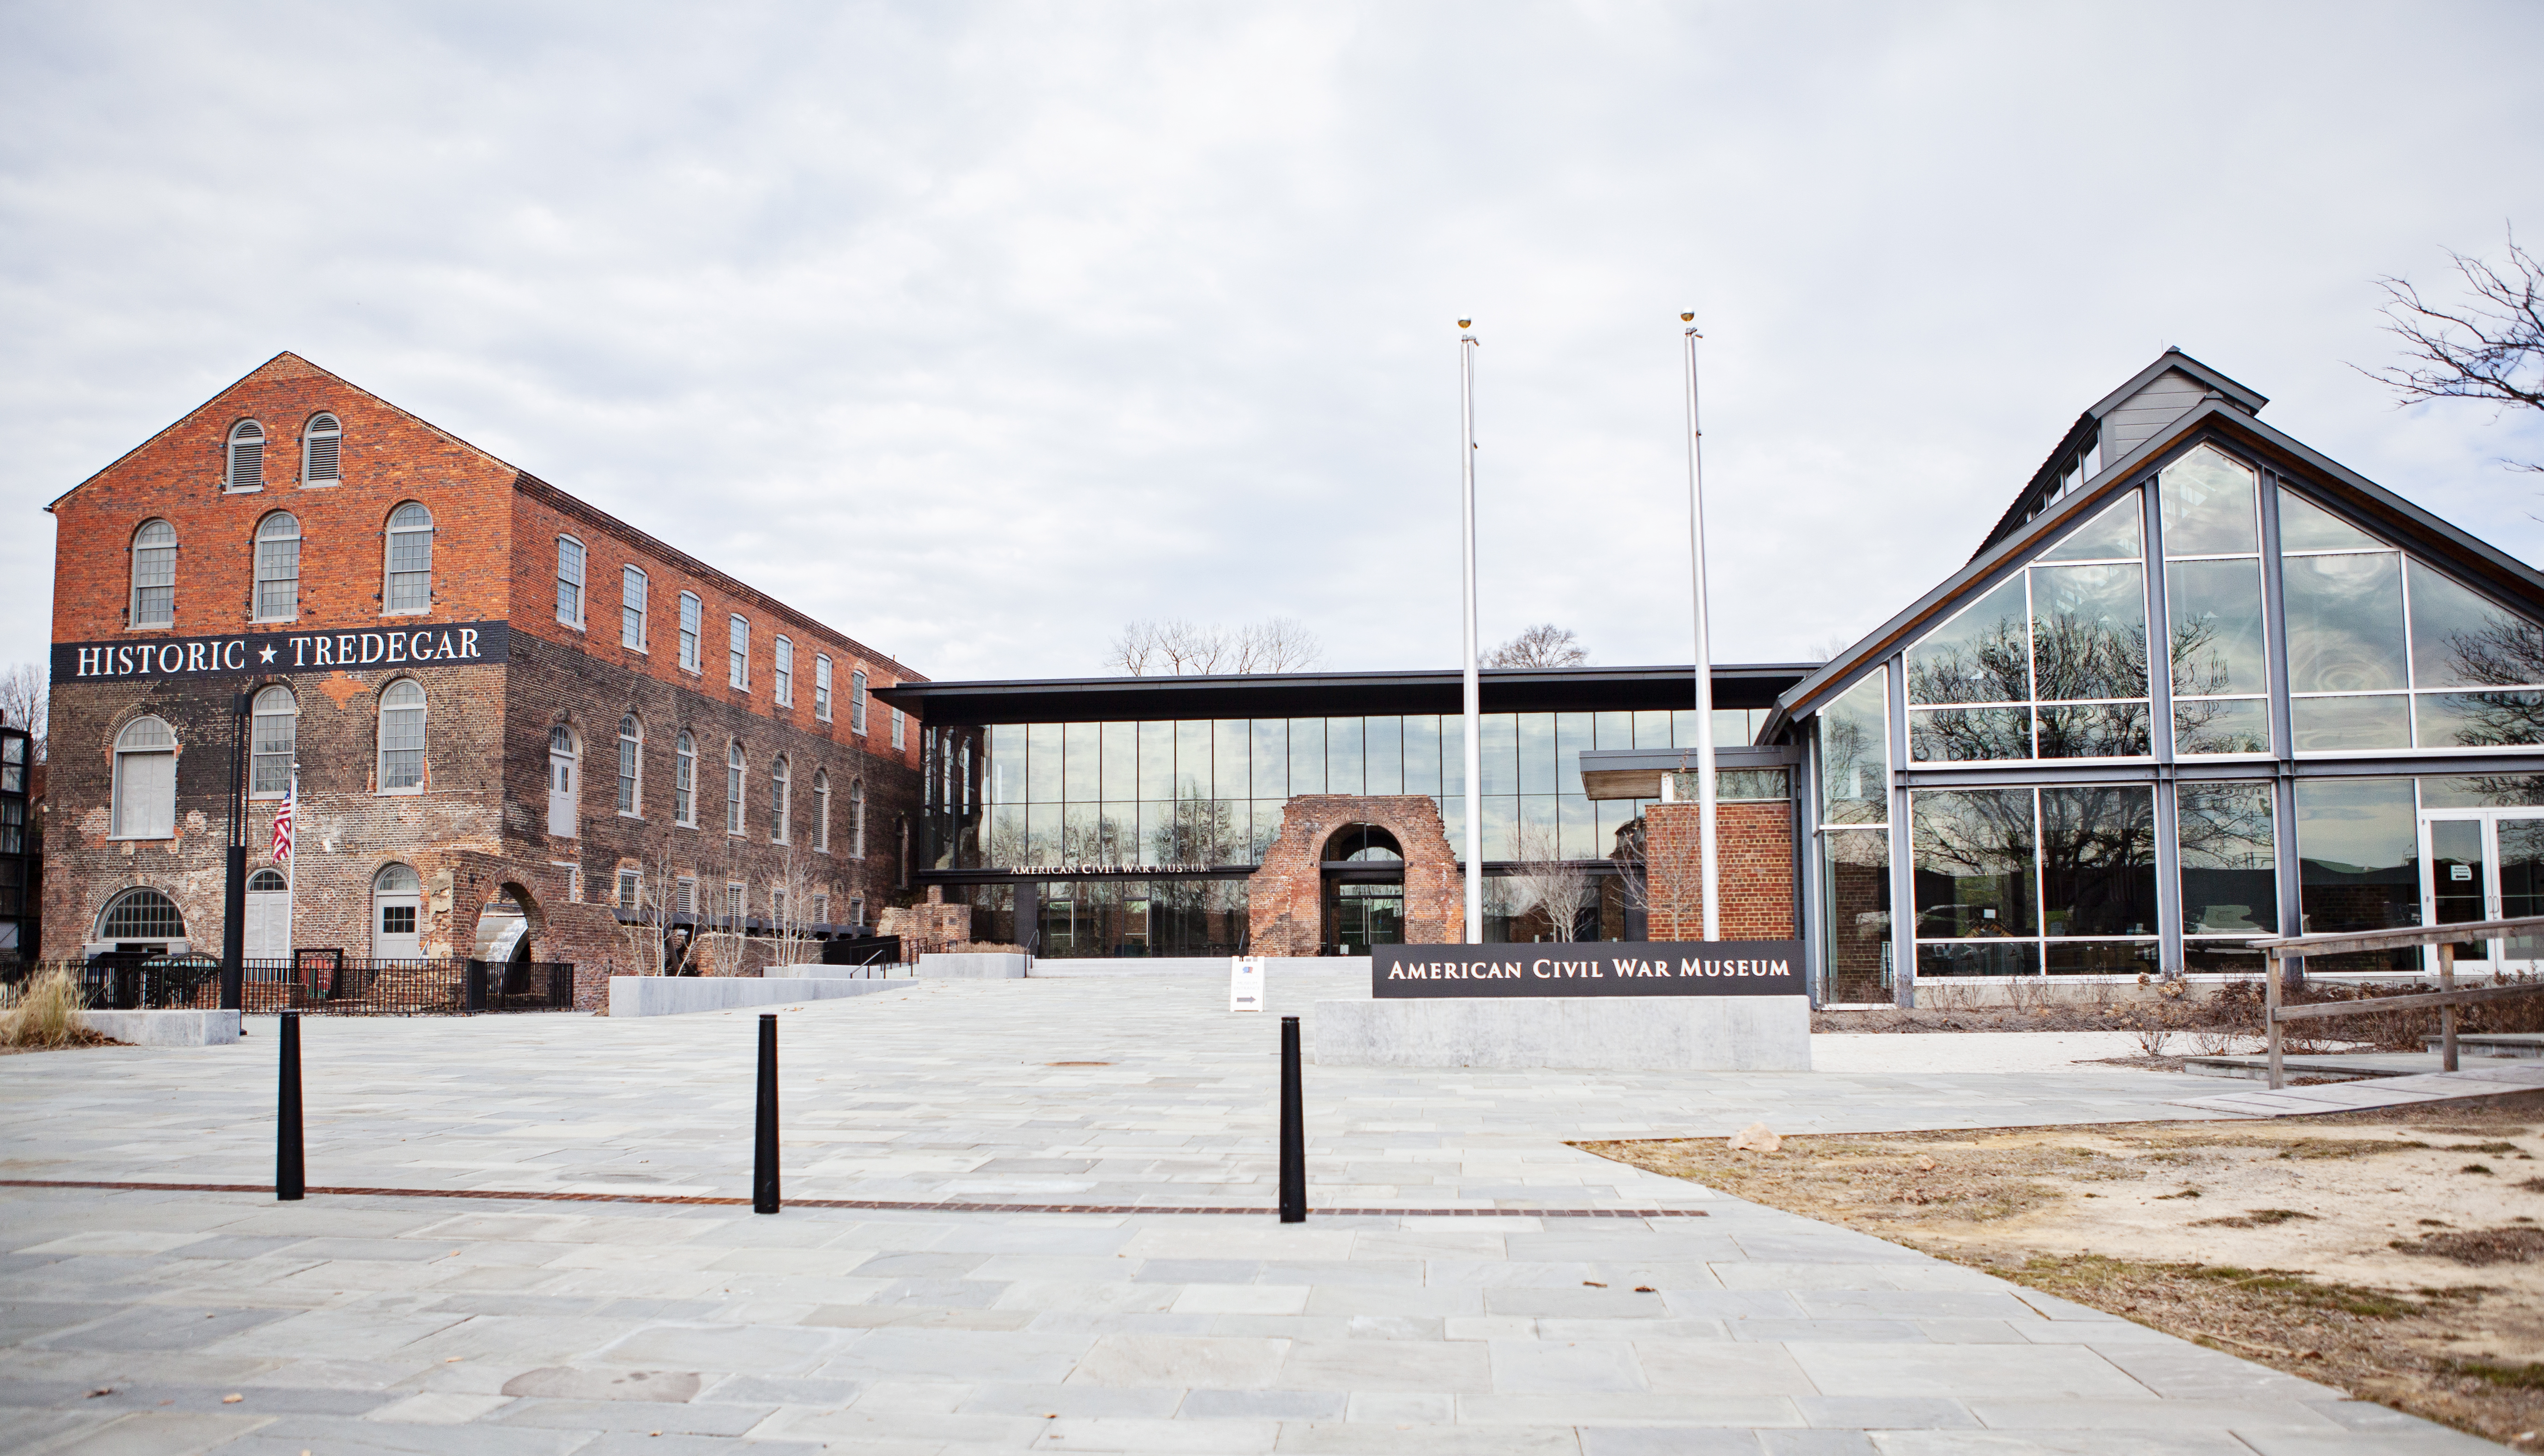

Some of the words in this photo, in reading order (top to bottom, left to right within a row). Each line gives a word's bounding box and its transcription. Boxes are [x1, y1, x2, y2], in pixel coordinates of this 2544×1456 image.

[77, 640, 245, 676] HISTORIC
[290, 629, 481, 667] TREDEGAR
[1010, 865, 1076, 874] AMERICAN
[1081, 864, 1117, 873] CIVIL
[1121, 863, 1151, 873] WAR
[1155, 863, 1211, 873] MUSEUM
[1387, 960, 1522, 980] AMERICAN
[1532, 959, 1604, 978] CIVIL
[1612, 958, 1672, 977] WAR
[1679, 957, 1791, 977] MUSEUM
